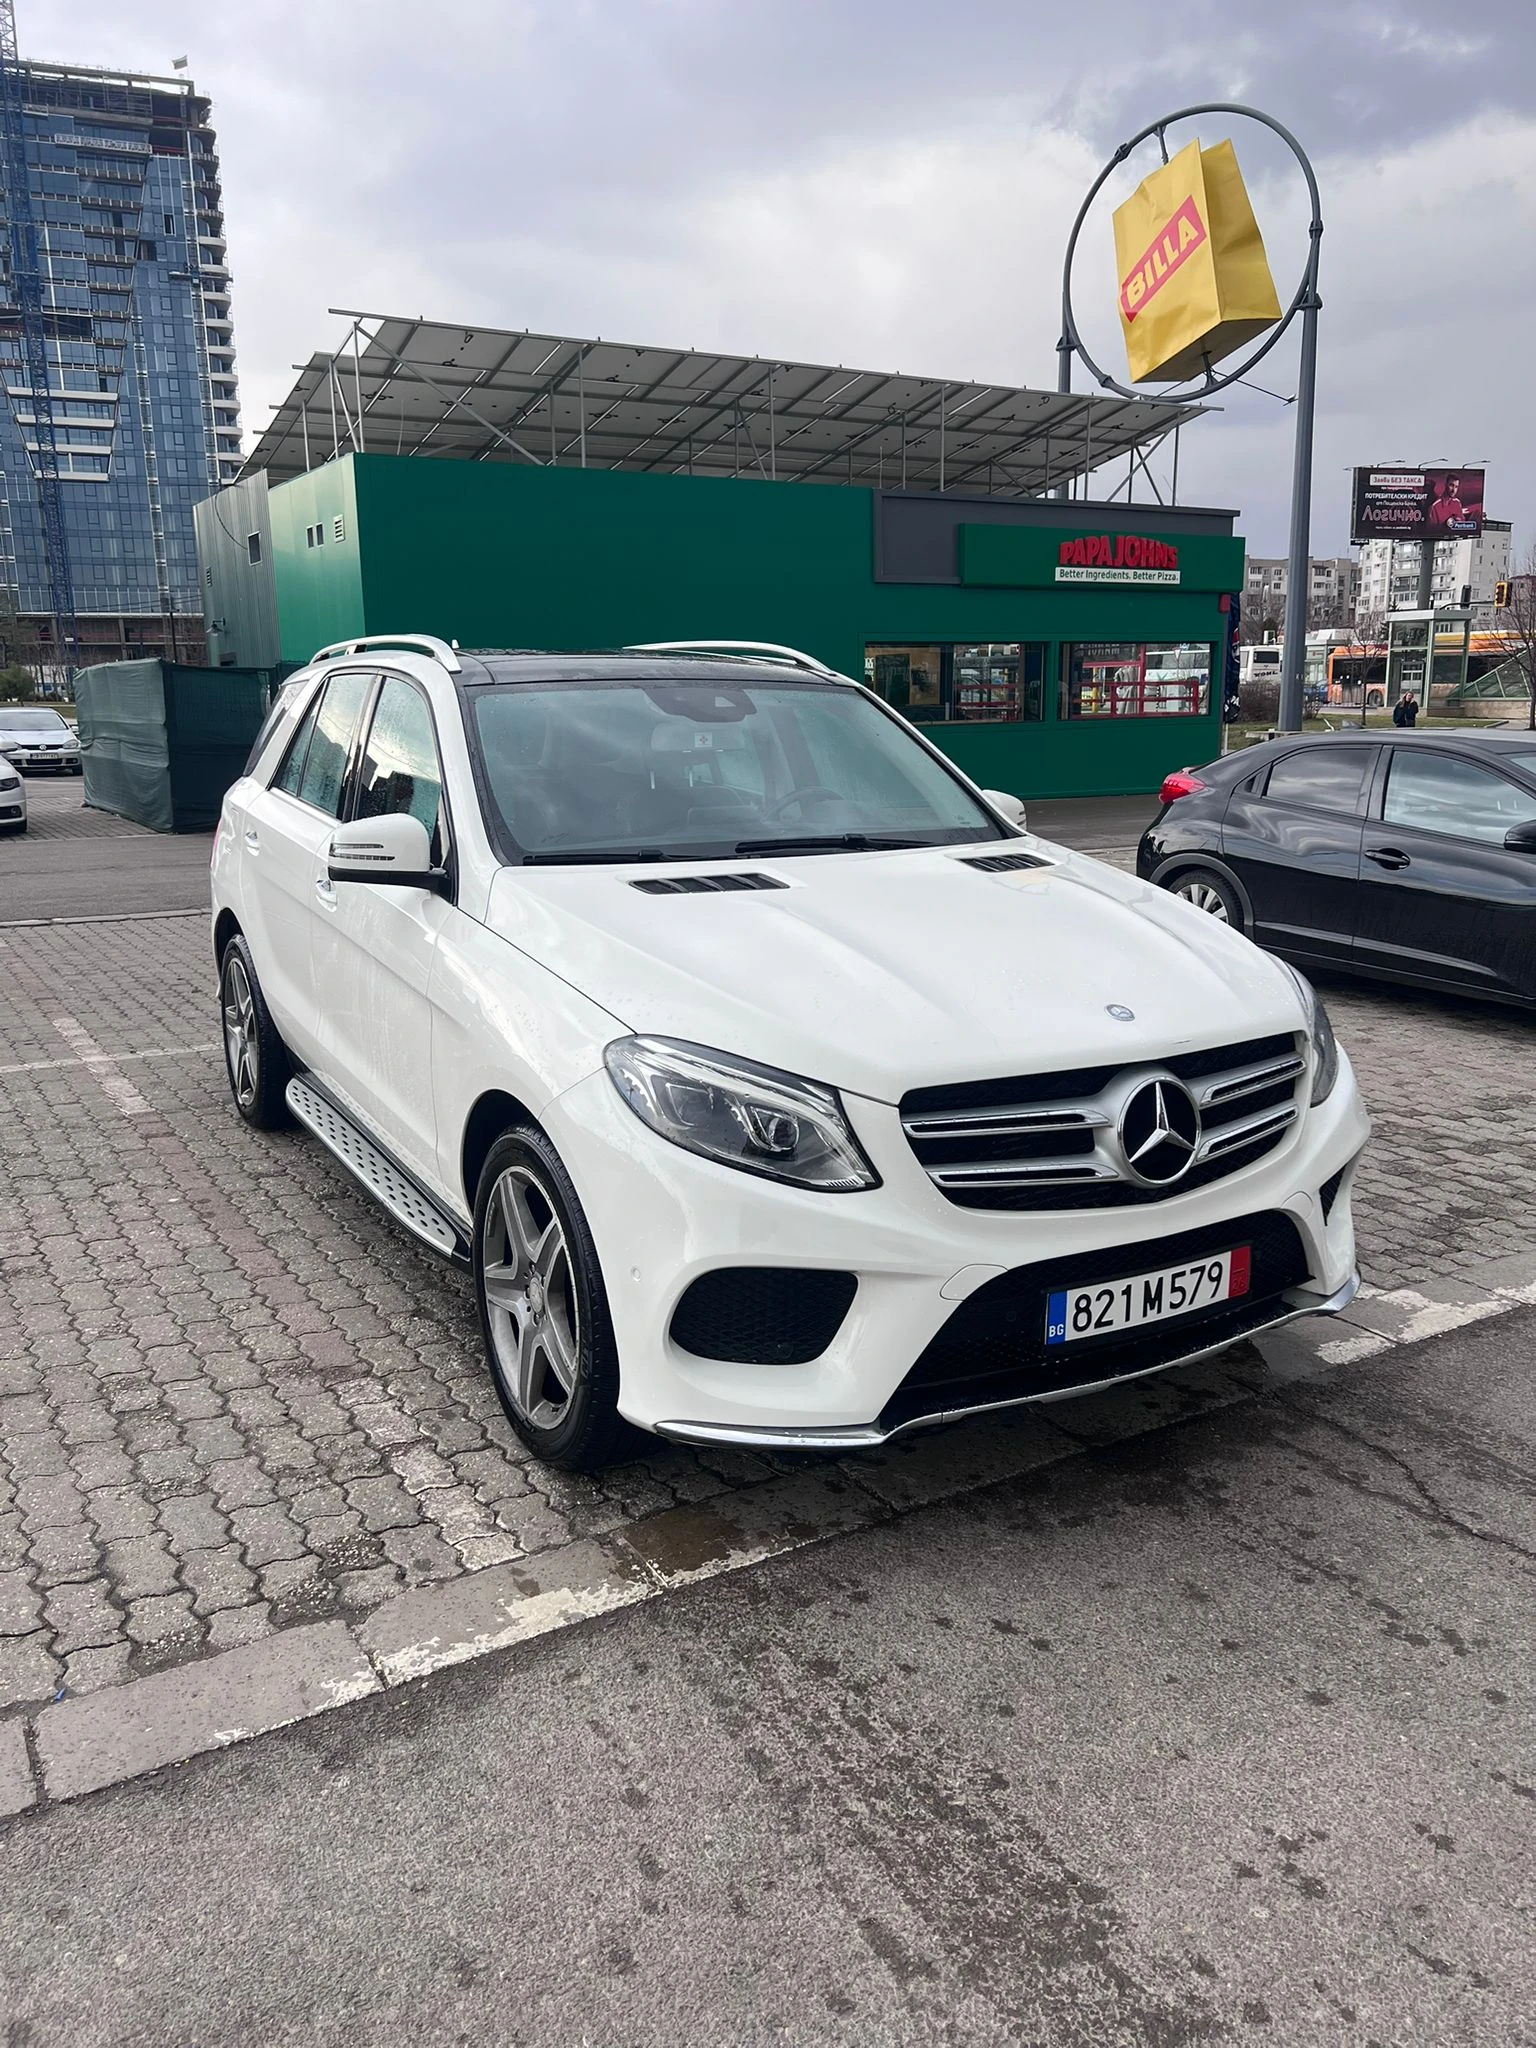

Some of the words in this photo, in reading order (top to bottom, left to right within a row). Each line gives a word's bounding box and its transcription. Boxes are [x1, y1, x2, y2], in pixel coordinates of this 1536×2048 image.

[1126, 215, 1199, 309] BILLA
[1059, 536, 1113, 566] PAPA
[1115, 535, 1178, 569] JOHNS
[1060, 569, 1084, 578] Better
[1085, 570, 1131, 580] Ingredients.
[1133, 571, 1156, 580] Better
[1157, 572, 1179, 581] Pizza.
[1049, 1323, 1064, 1337] BG
